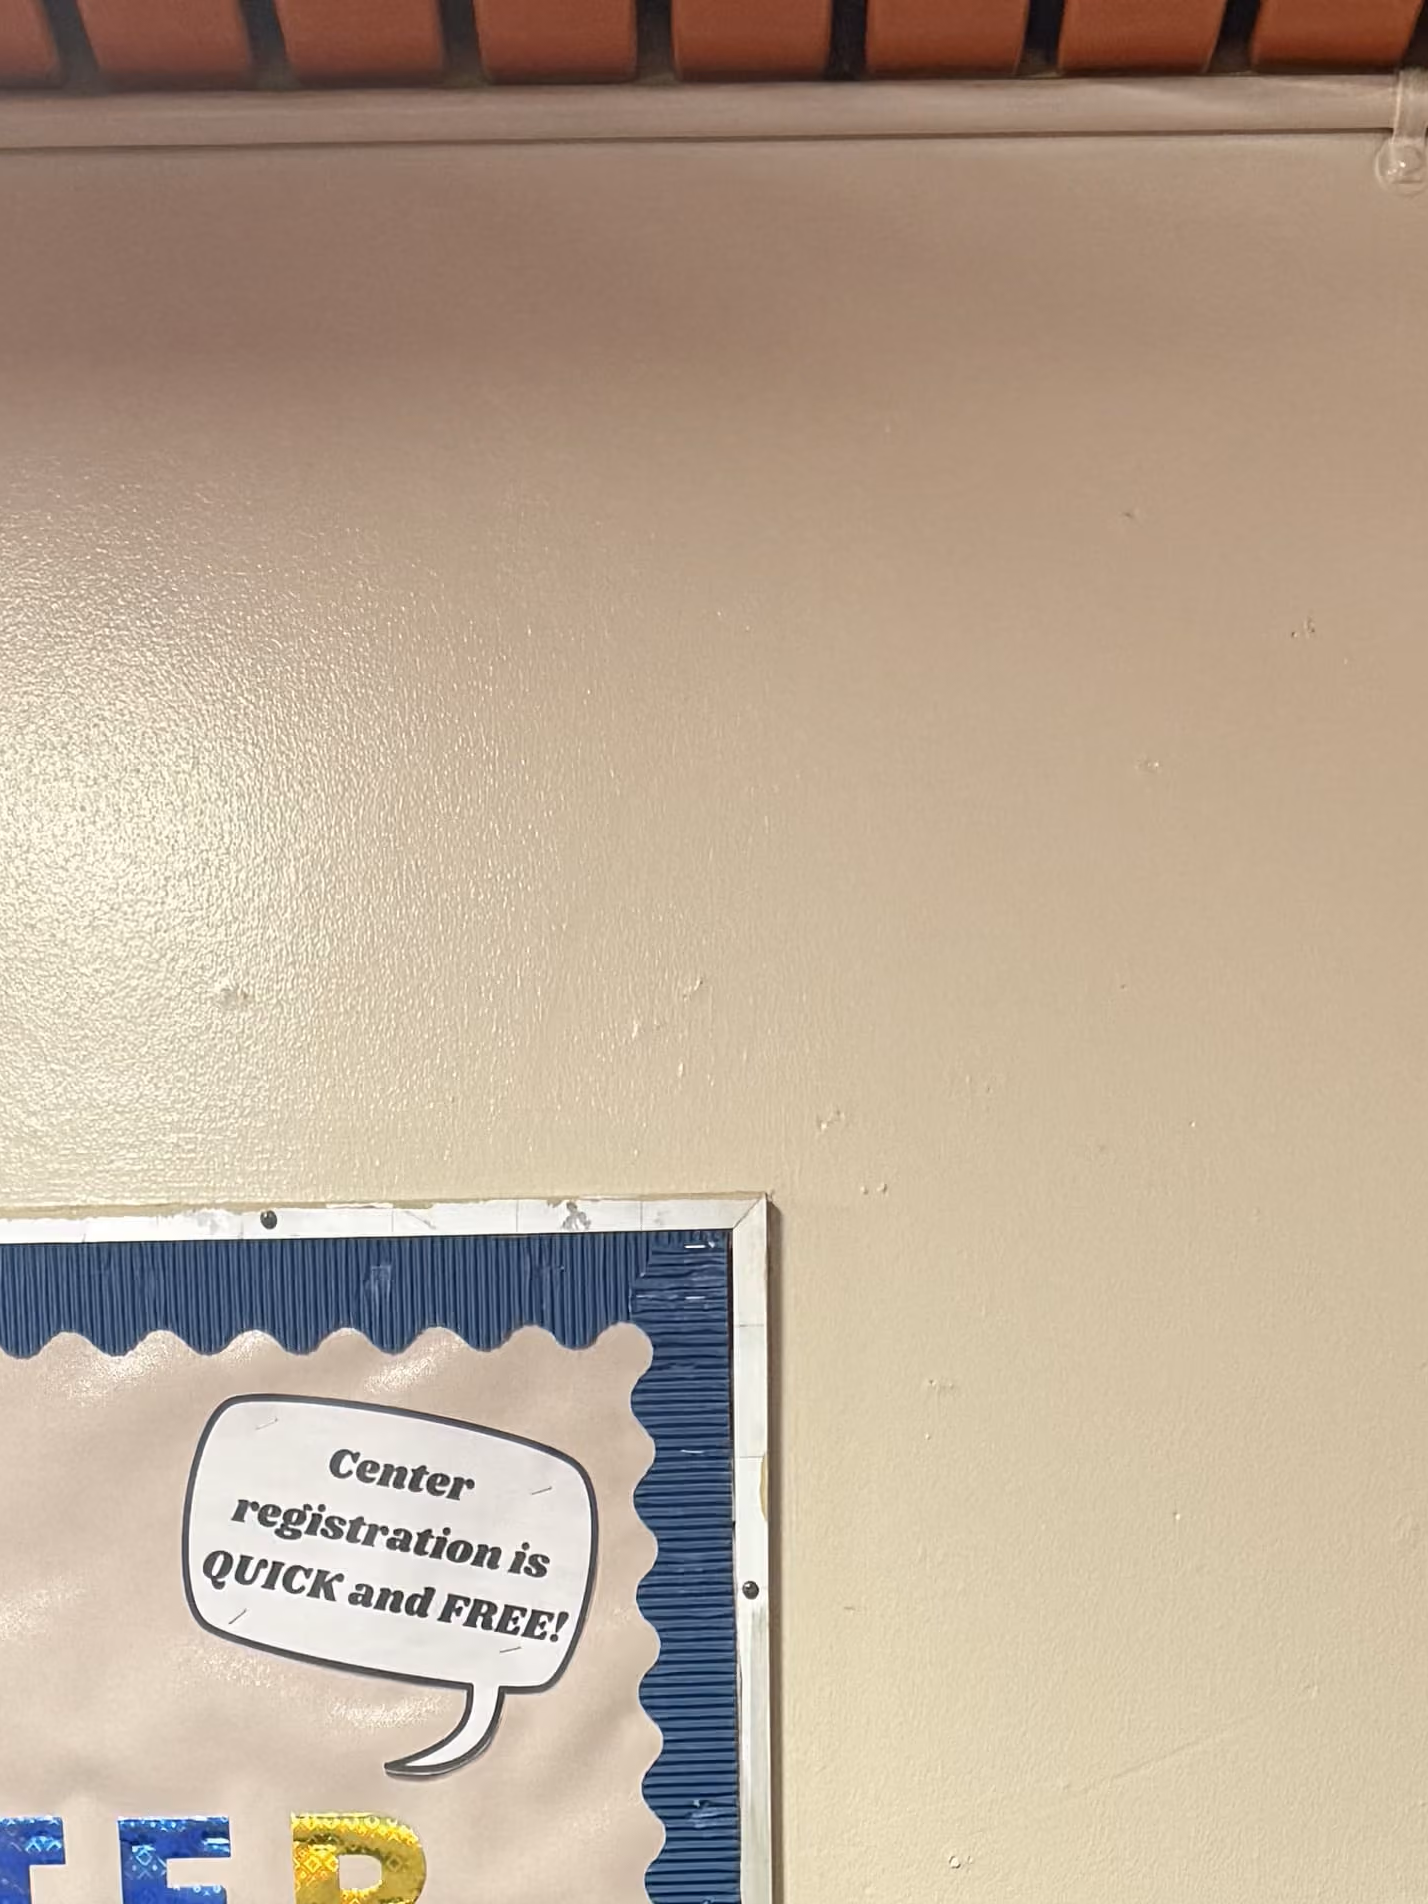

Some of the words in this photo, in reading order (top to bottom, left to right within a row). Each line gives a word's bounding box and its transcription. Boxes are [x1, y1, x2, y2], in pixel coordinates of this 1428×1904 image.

[329, 1448, 476, 1500] Center
[230, 1499, 503, 1570] registration
[508, 1541, 551, 1578] is
[202, 1550, 345, 1602] QUICK
[347, 1582, 437, 1618] and
[436, 1594, 570, 1643] FREE!
